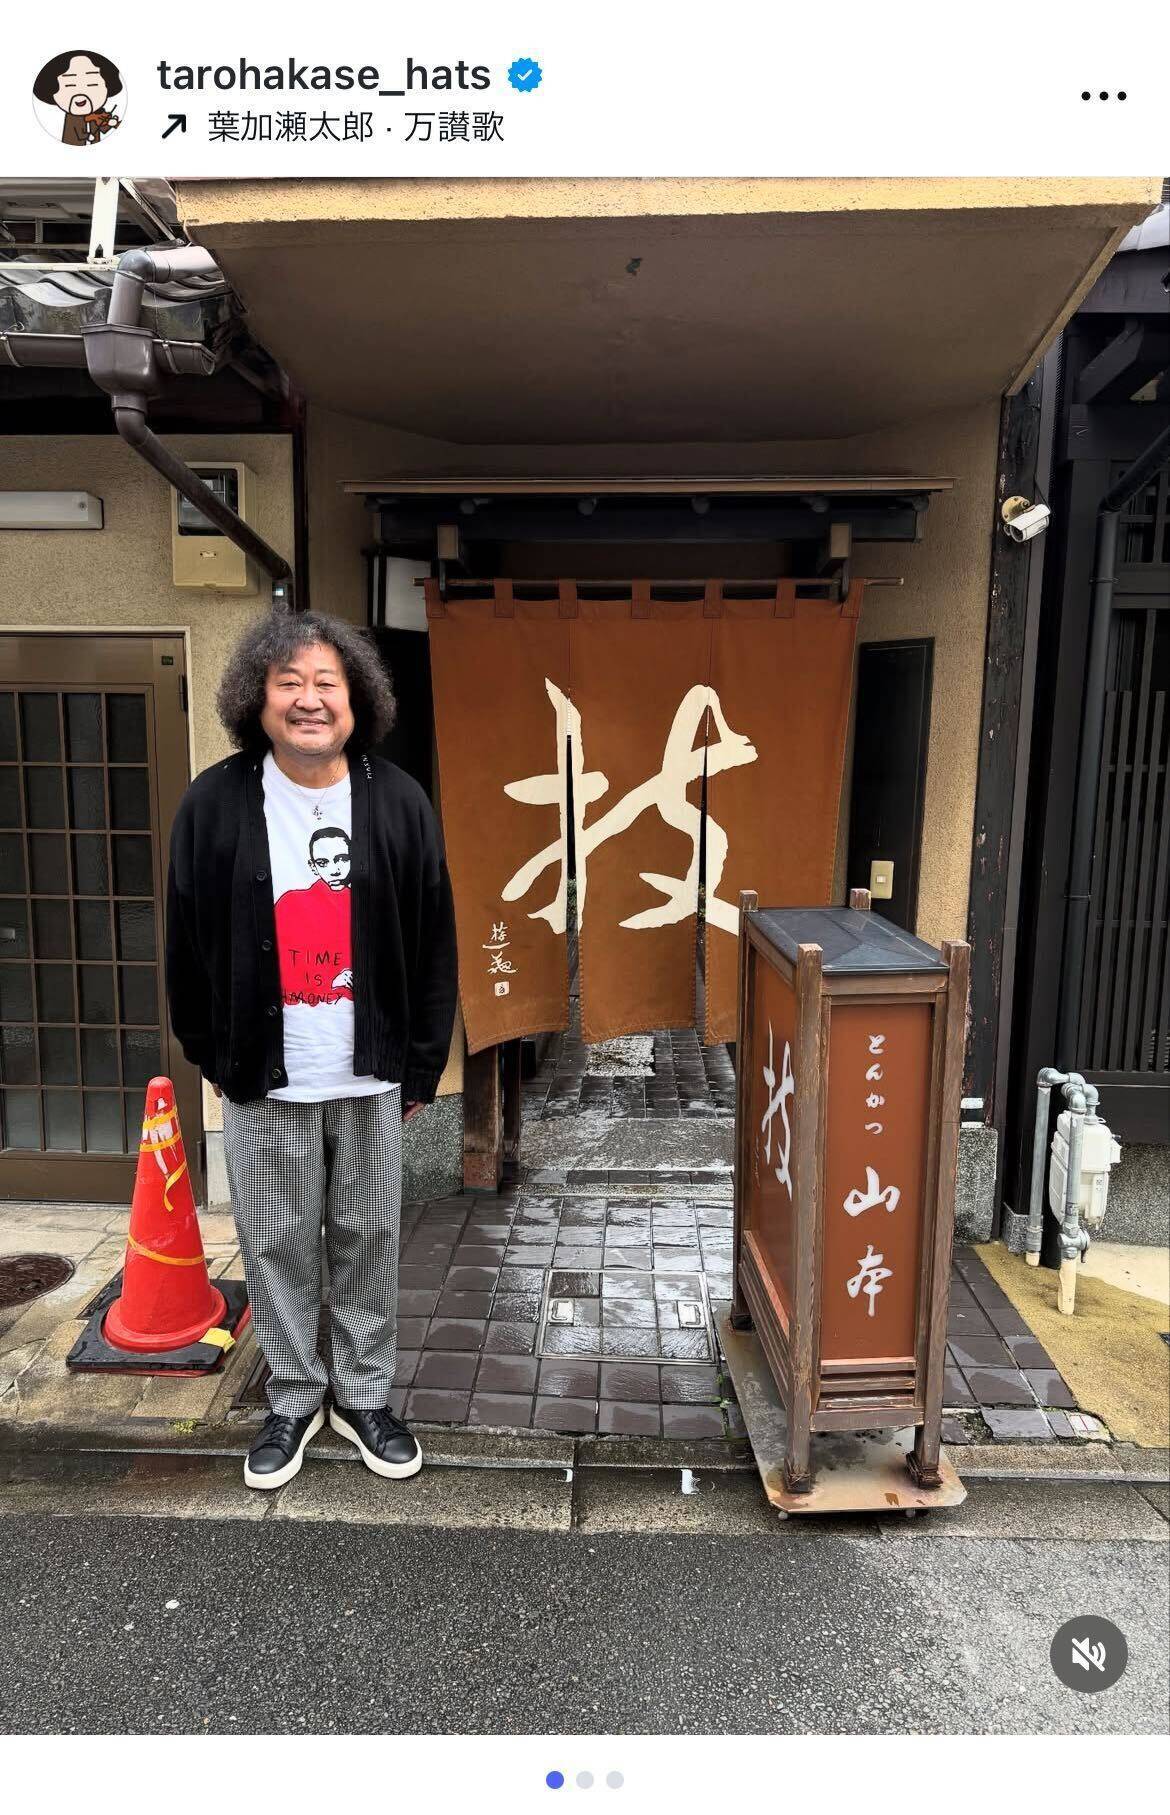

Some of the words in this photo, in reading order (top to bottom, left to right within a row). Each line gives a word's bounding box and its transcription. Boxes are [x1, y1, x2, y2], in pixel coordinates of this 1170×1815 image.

[501, 677, 759, 936] 技
[288, 949, 342, 967] TIME
[306, 972, 322, 986] IS
[865, 1034, 885, 1135] とんかつ
[843, 1166, 900, 1317] 山本
